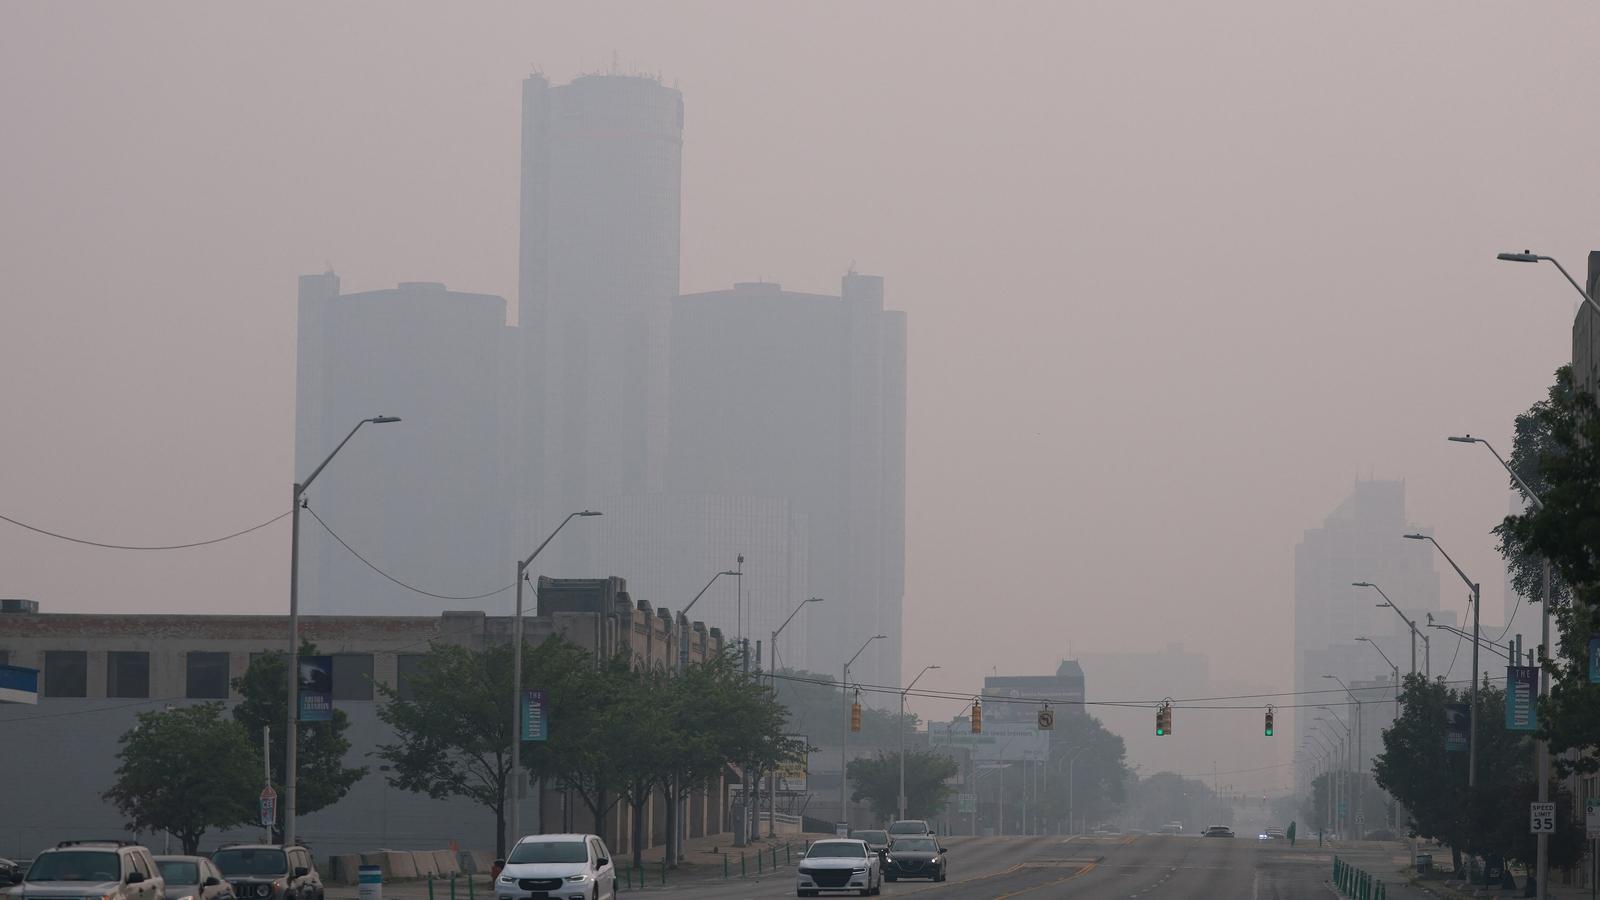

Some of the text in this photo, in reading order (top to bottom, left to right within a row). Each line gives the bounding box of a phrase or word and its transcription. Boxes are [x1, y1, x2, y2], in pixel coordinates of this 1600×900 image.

[1515, 669, 1530, 678] THE
[1514, 680, 1530, 725] ARETHA
[1533, 818, 1553, 830] 35
